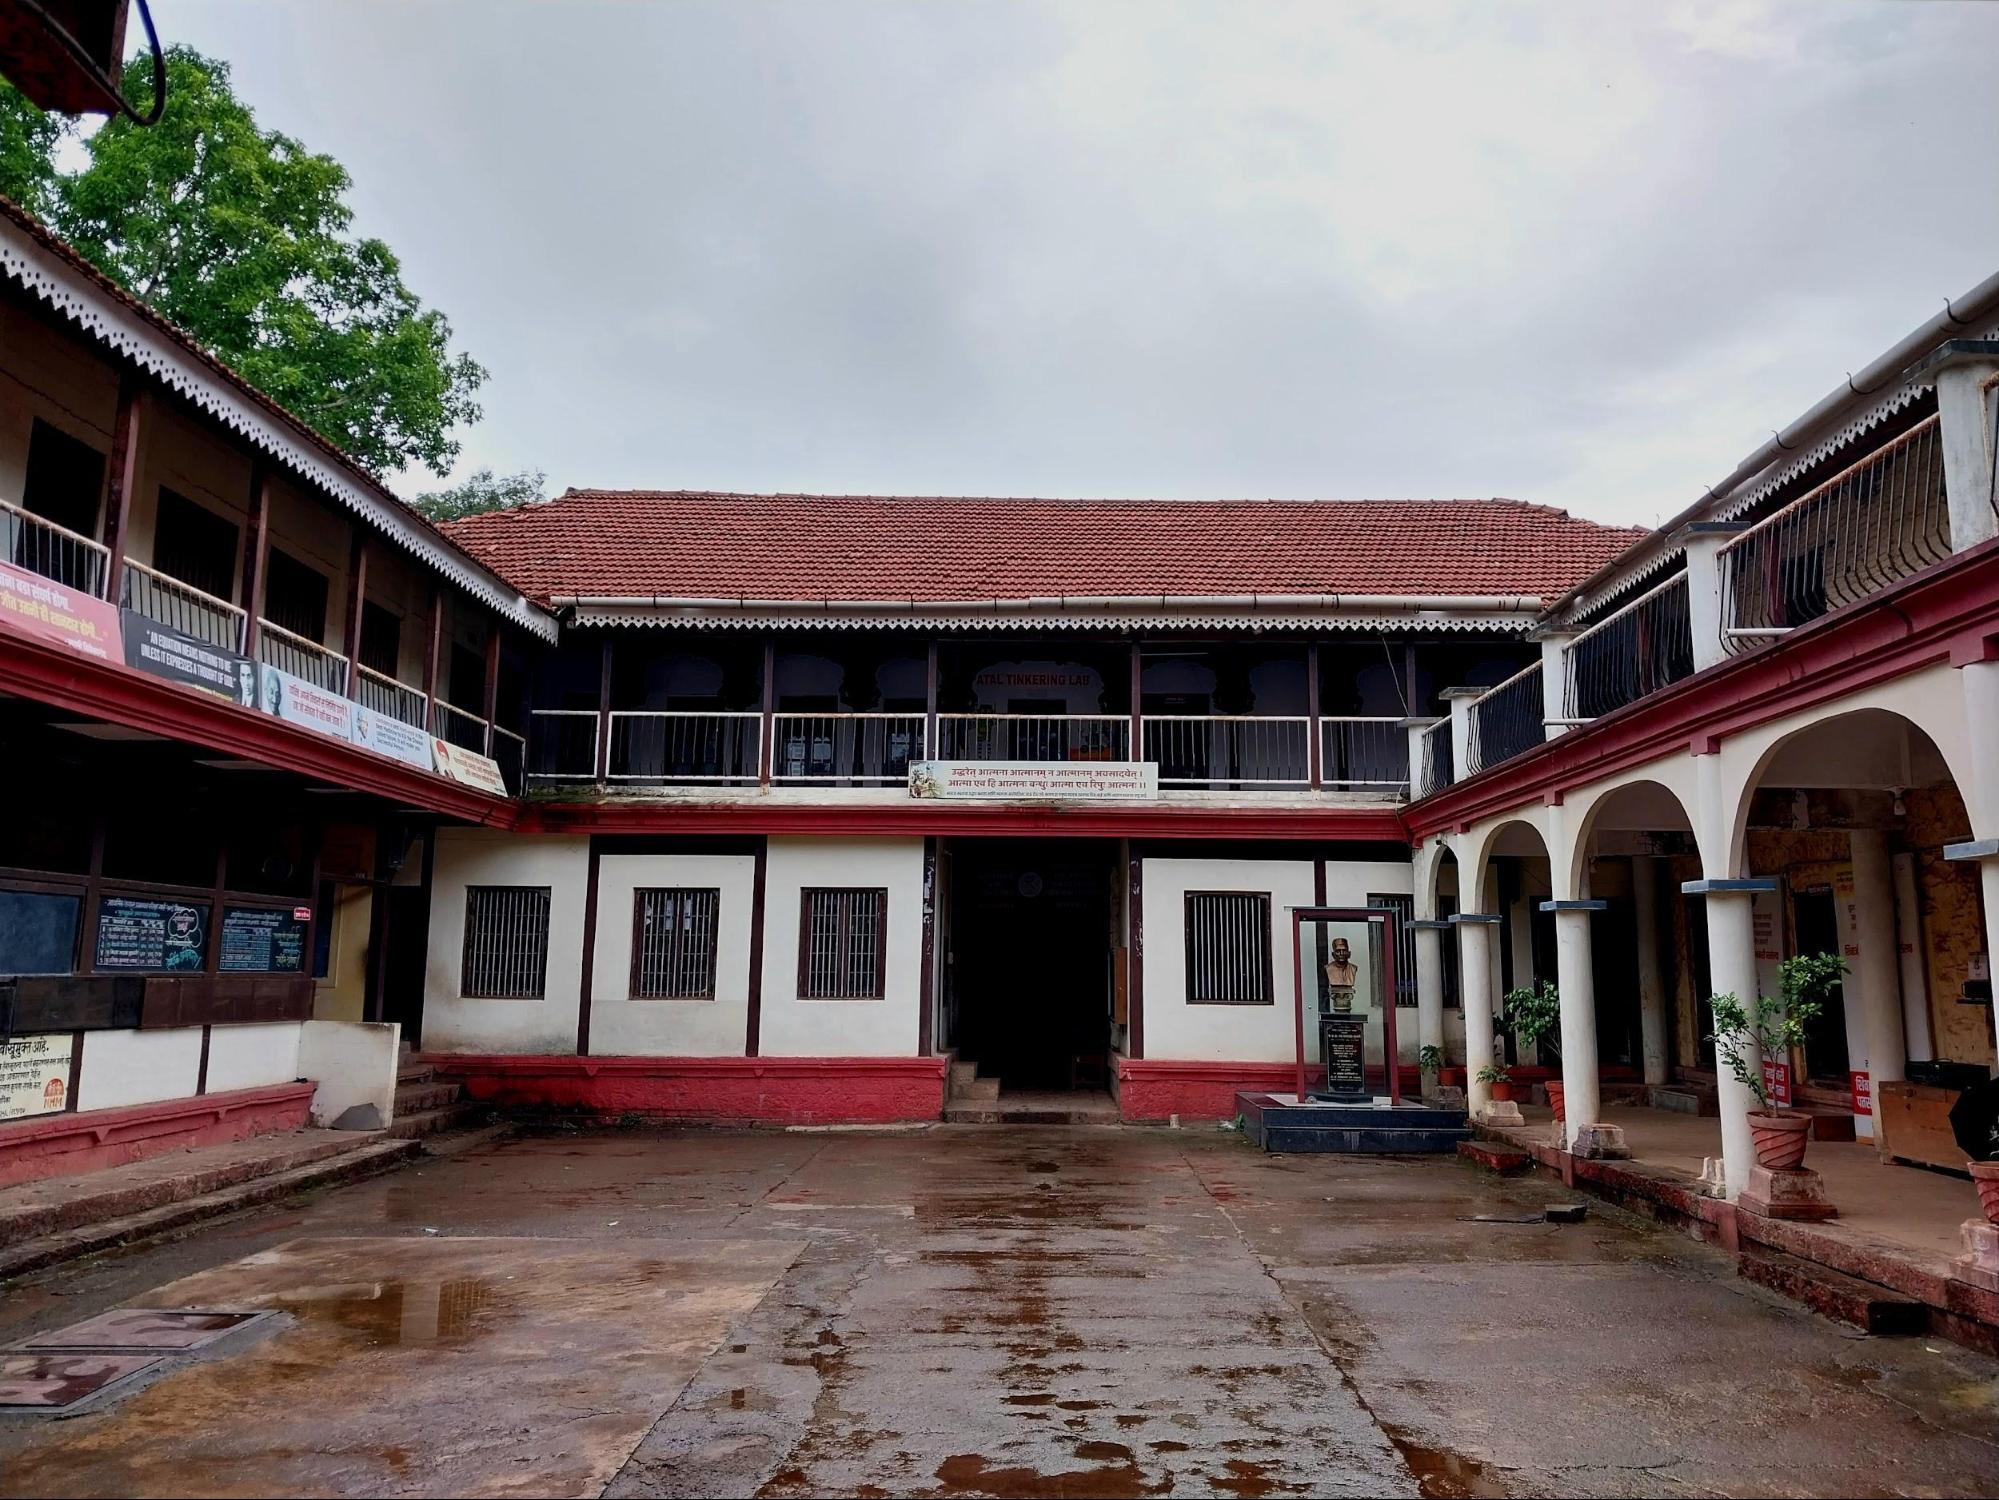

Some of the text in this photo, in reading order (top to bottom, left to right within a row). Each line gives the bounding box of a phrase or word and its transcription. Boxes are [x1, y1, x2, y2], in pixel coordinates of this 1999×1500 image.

[159, 634, 182, 654] EQUATION
[182, 643, 198, 660] MEANS
[141, 643, 160, 661] UNLESS
[167, 653, 192, 672] EXPRESSES
[977, 674, 1090, 685] ATAL TINKERING LAB
[952, 767, 976, 777] उद्धरेत्
[1010, 770, 1046, 779] आत्मानम्
[1056, 770, 1092, 779] आत्मानम्
[1094, 768, 1137, 779] अवसादयेत्
[987, 777, 996, 788] हि
[32, 1041, 49, 1056] आहे.
